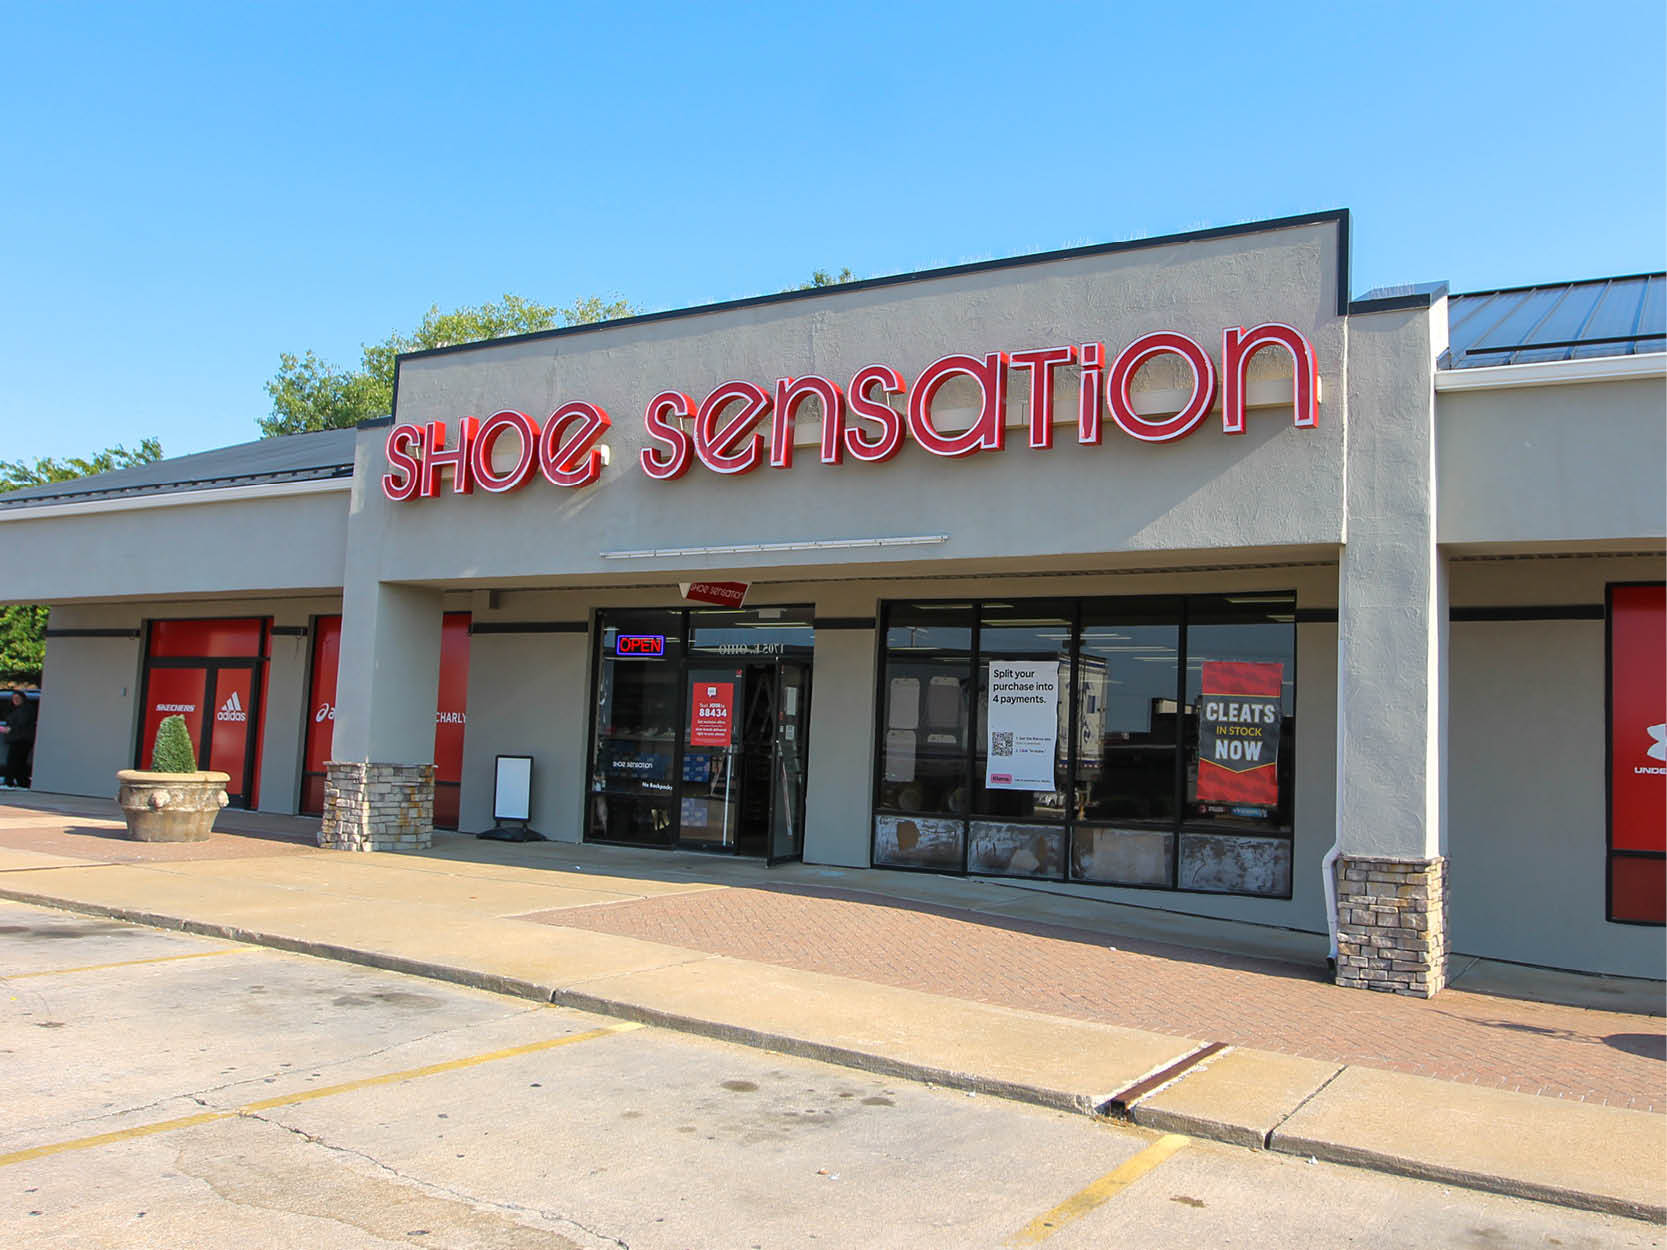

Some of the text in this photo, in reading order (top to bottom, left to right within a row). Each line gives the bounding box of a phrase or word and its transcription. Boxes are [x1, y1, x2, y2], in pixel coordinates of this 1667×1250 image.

[620, 637, 661, 653] OPEN
[993, 669, 1035, 680] Split your
[993, 682, 1054, 692] purchase into
[993, 695, 1047, 705] 4 payments.
[217, 711, 246, 721] adidas
[435, 711, 468, 724] CHARLY
[699, 708, 728, 718] 88434
[1206, 702, 1276, 724] CLEATS
[1216, 726, 1263, 737] IN STOCK
[1215, 739, 1263, 761] NOW
